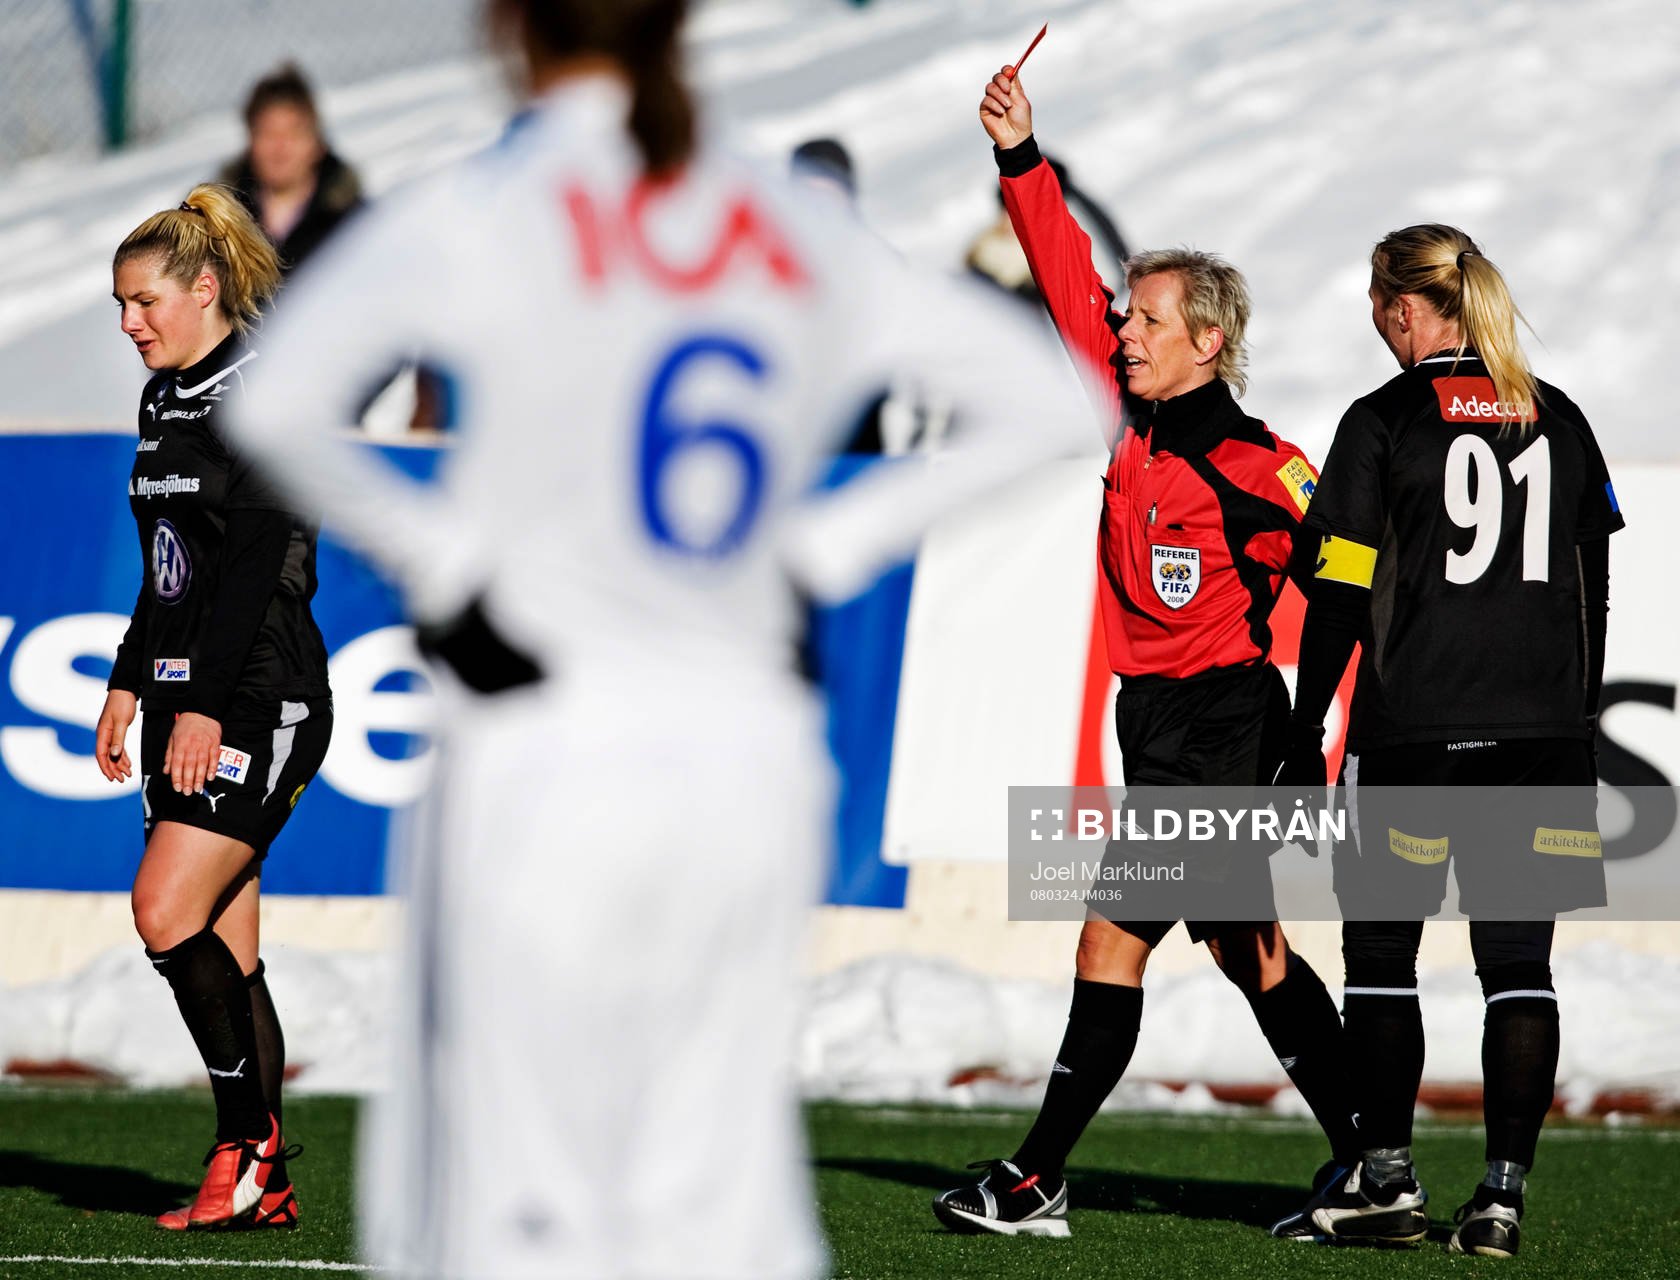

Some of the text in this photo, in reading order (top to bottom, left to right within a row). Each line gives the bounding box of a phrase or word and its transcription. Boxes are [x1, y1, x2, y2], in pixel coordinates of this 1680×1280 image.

[636, 332, 772, 560] 6
[137, 474, 200, 500] Myresjöhus
[1444, 433, 1551, 585] 91
[1154, 548, 1198, 560] REFEREE
[1161, 581, 1192, 594] FIFA
[1166, 595, 1185, 604] 2008
[167, 661, 187, 670] INTER
[167, 670, 188, 679] SPORT
